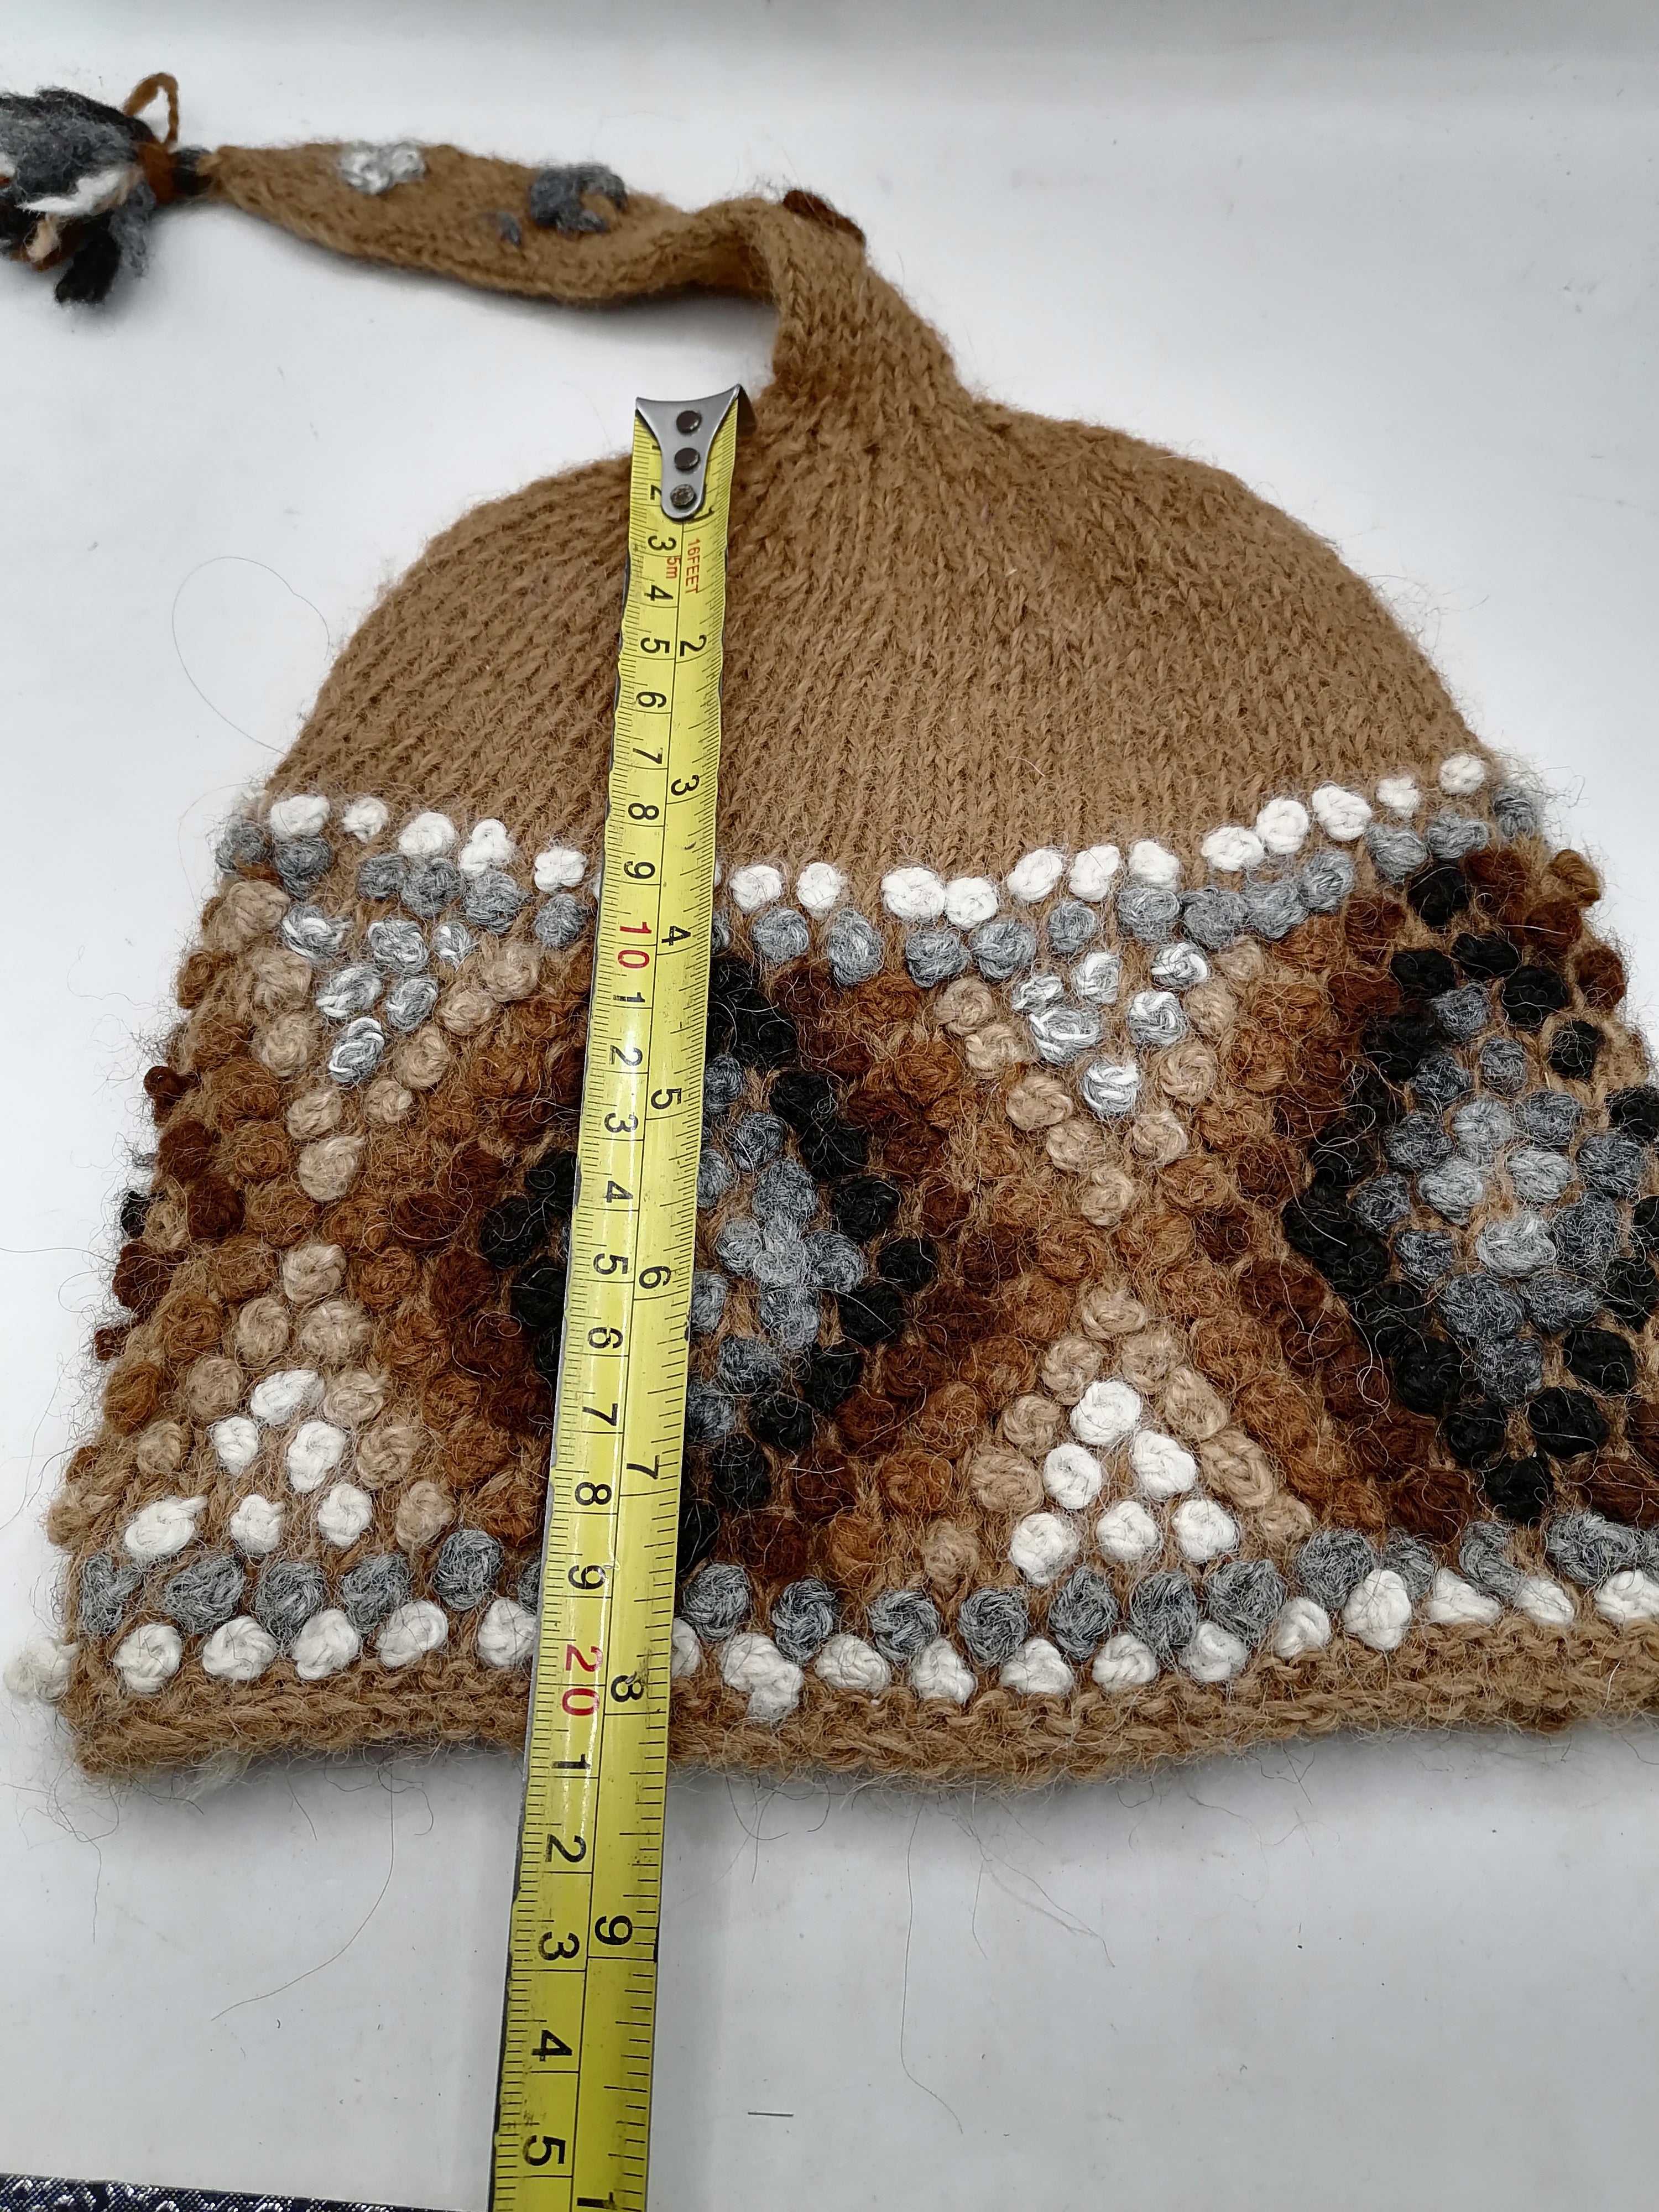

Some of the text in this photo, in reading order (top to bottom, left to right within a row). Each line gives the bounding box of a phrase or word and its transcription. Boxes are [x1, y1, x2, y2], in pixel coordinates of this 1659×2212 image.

[648, 535, 677, 551] 3
[666, 556, 682, 579] 5m
[685, 538, 701, 594] 16FEET
[644, 585, 673, 601] 4
[640, 637, 670, 654] 5
[680, 634, 707, 657] 2
[636, 691, 667, 708] 6
[633, 747, 664, 765] 7
[671, 774, 700, 796] 3
[628, 802, 660, 821] 8
[623, 860, 656, 880] 9
[617, 921, 652, 969] 10
[661, 925, 691, 946] 4
[613, 992, 646, 1003] 1
[609, 1045, 643, 1067] 2
[650, 1088, 682, 1110] 5
[604, 1112, 639, 1133] 3
[603, 1180, 634, 1203] 4
[593, 1253, 629, 1275] 5
[639, 1265, 671, 1290] 6
[588, 1327, 623, 1349] 6
[582, 1403, 618, 1427] 7
[626, 1454, 660, 1480] 7
[575, 1481, 612, 1506] 8
[568, 1564, 607, 1590] 9
[562, 1644, 603, 1717] 20
[611, 1674, 644, 1703] 8
[552, 1754, 592, 1769] 1
[545, 1833, 587, 1863] 2
[594, 1915, 633, 1946] 9
[538, 1931, 580, 1961] 3
[531, 2030, 573, 2062] 4
[523, 2135, 566, 2167] 5
